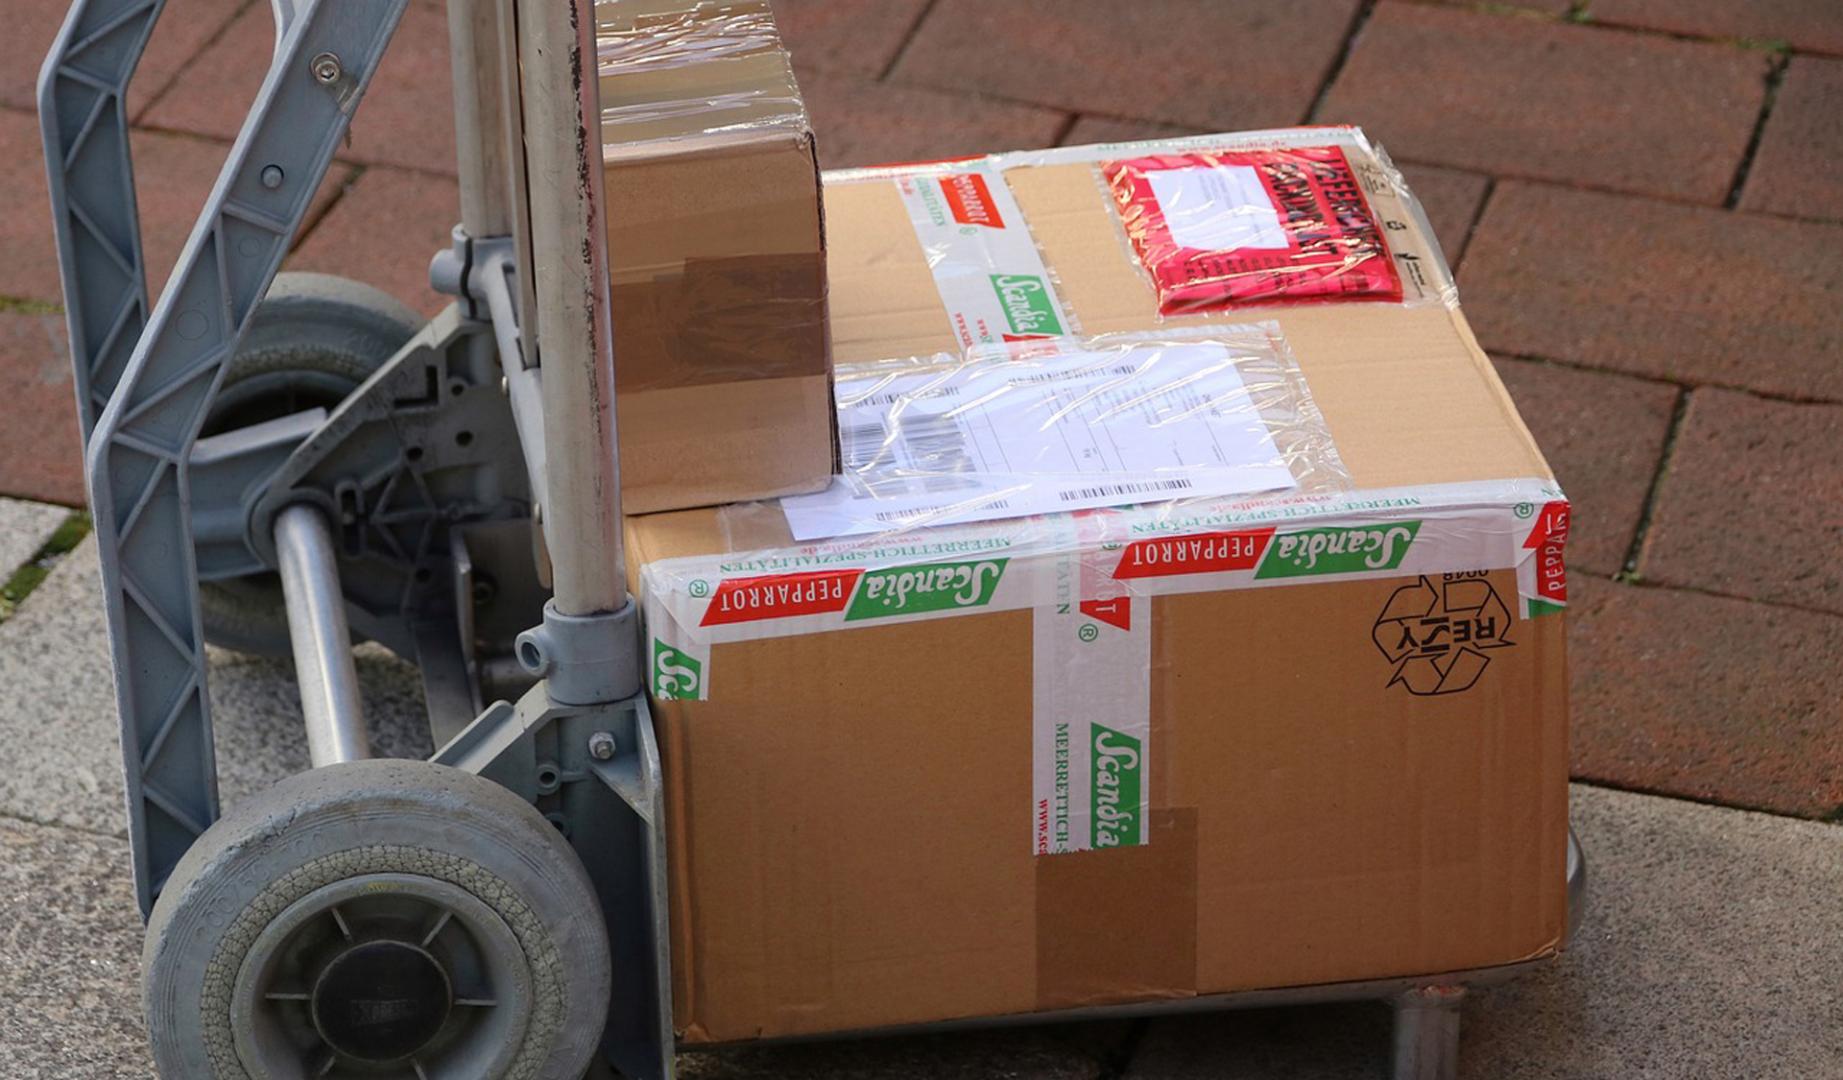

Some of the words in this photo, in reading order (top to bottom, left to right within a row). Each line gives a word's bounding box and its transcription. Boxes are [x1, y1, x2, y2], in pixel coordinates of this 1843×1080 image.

[997, 275, 1047, 332] Scandia
[1132, 536, 1255, 567] PEPPARROT
[1277, 525, 1411, 570] Scandia
[720, 577, 843, 612] PEPPARROT
[866, 561, 999, 609] Scandia
[1095, 731, 1139, 847] Scandia
